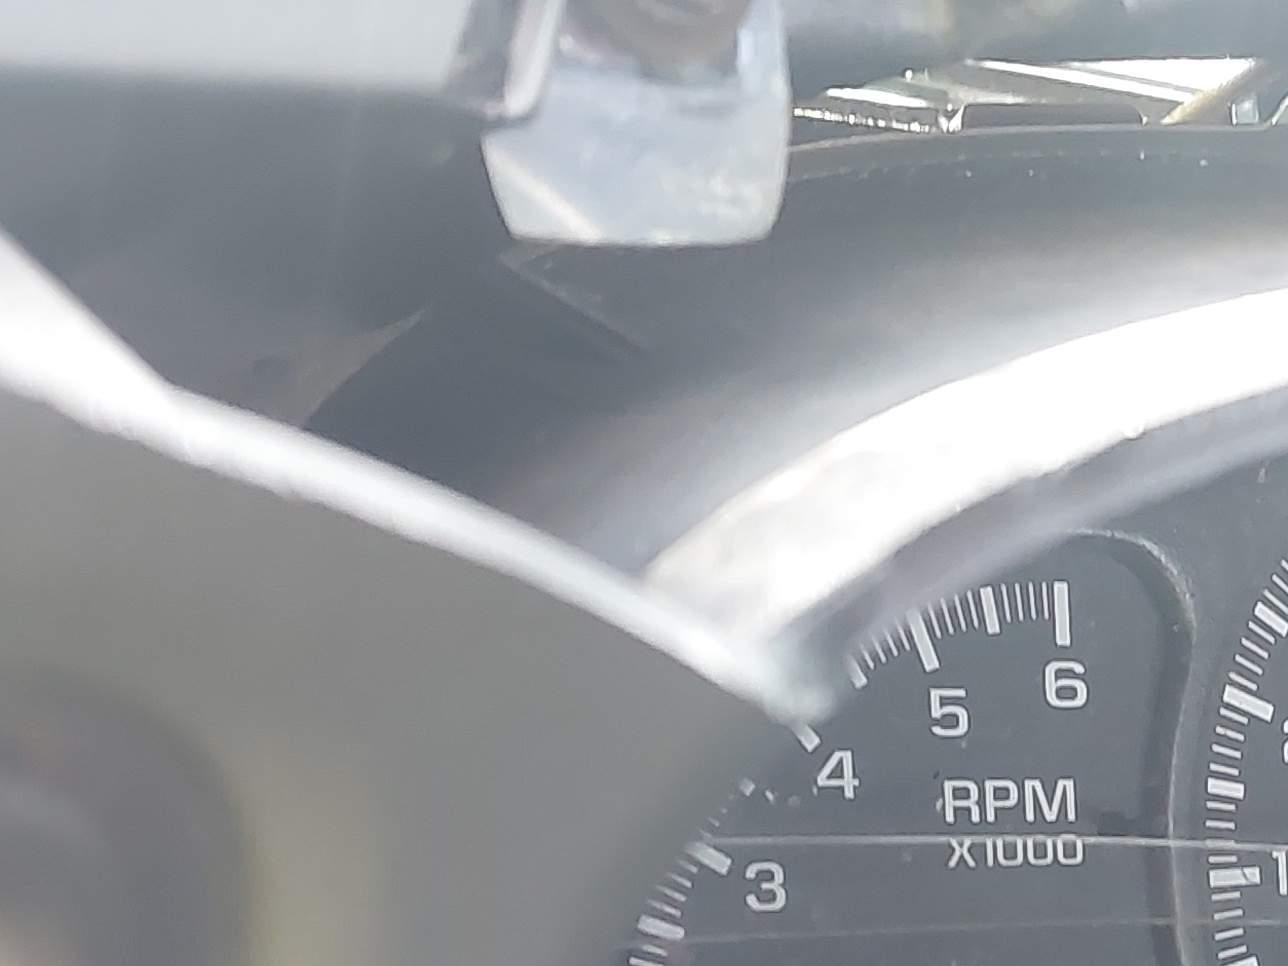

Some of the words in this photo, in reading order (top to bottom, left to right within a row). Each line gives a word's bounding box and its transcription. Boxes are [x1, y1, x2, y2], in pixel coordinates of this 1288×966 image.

[1044, 661, 1088, 709] 6
[929, 688, 969, 737] 5
[816, 750, 860, 800] 4
[944, 778, 1076, 824] RPM
[948, 834, 1083, 867] X1000
[745, 862, 787, 912] 3
